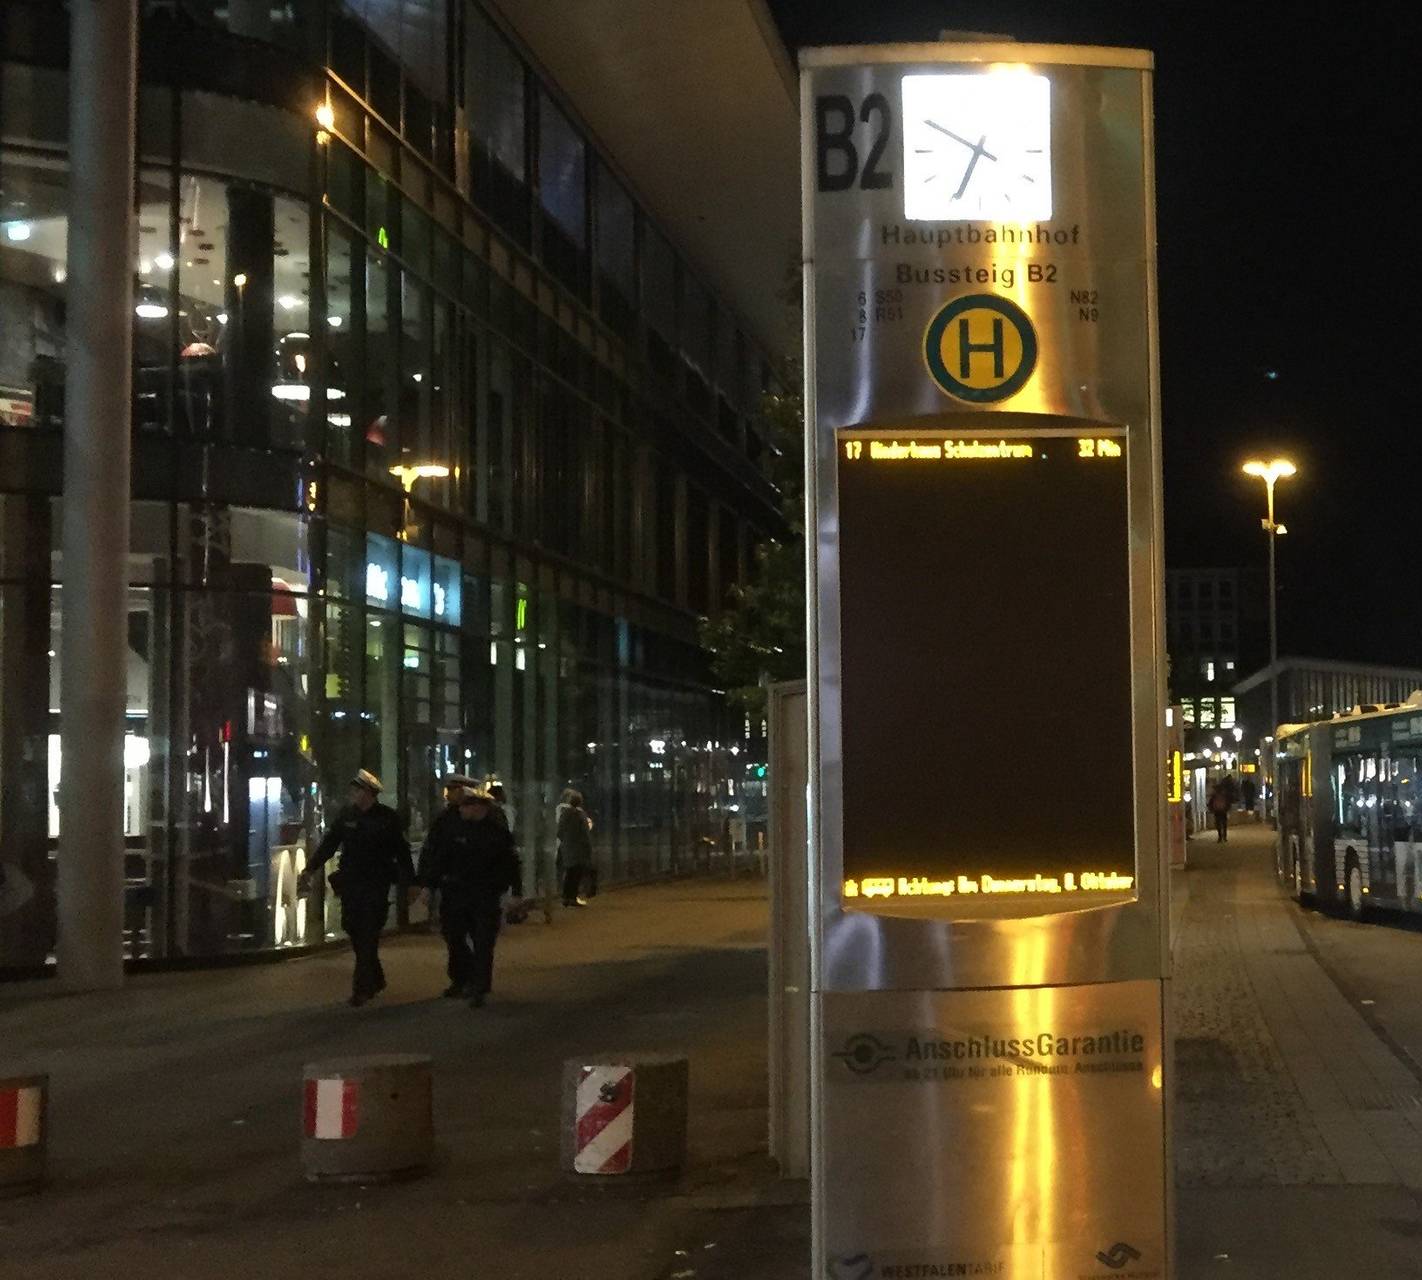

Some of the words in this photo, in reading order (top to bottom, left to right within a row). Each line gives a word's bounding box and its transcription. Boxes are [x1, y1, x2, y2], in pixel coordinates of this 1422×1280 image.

[816, 92, 893, 192] B2
[882, 224, 1080, 248] Hauptbahnhof
[896, 263, 1014, 288] Bussteig
[1027, 263, 1058, 283] B2
[1070, 289, 1098, 305] N82
[1079, 307, 1099, 322] N9
[851, 327, 866, 341] 17
[959, 317, 1005, 379] H
[846, 440, 862, 460] 17
[906, 1031, 1145, 1061] AnschlussGarantie
